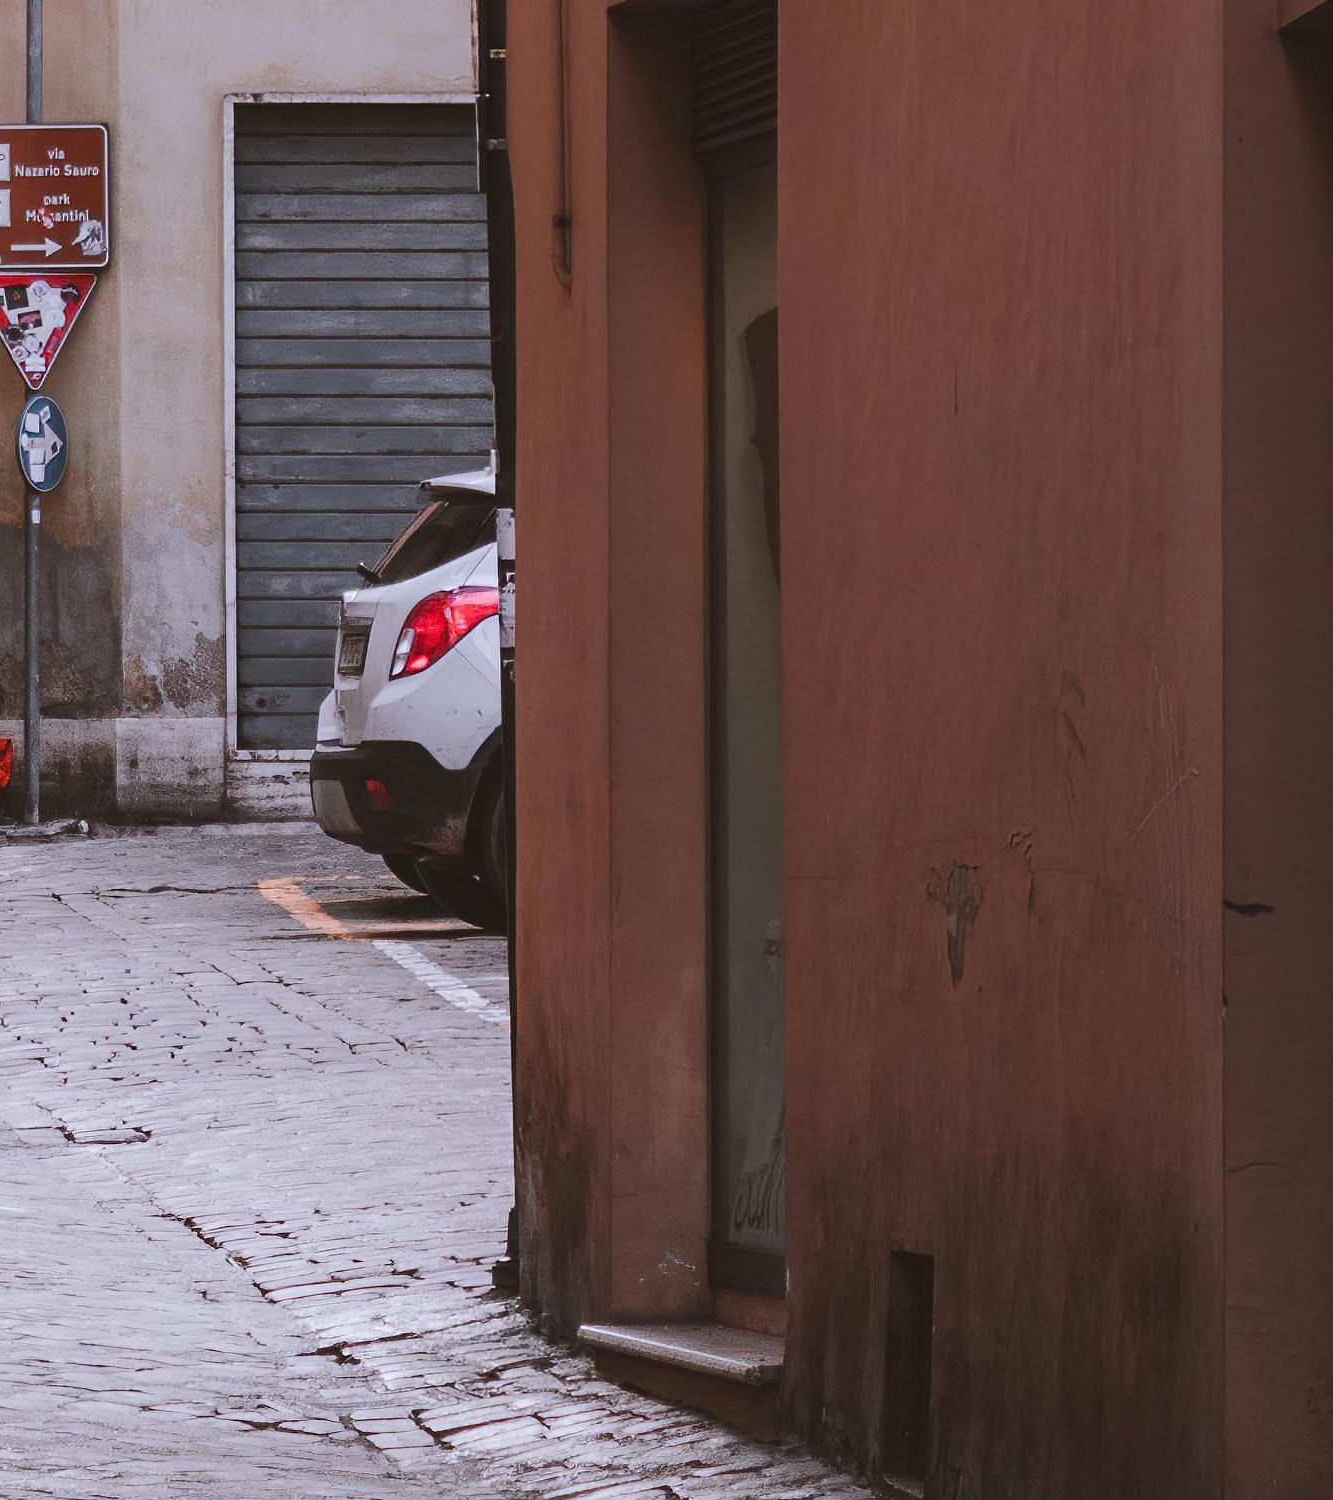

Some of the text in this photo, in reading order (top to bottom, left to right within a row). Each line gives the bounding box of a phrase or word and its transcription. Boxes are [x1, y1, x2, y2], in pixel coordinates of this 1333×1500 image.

[48, 147, 65, 159] via
[15, 164, 99, 177] Nazario Sauro
[43, 193, 70, 206] park
[26, 209, 89, 222] Mantini
